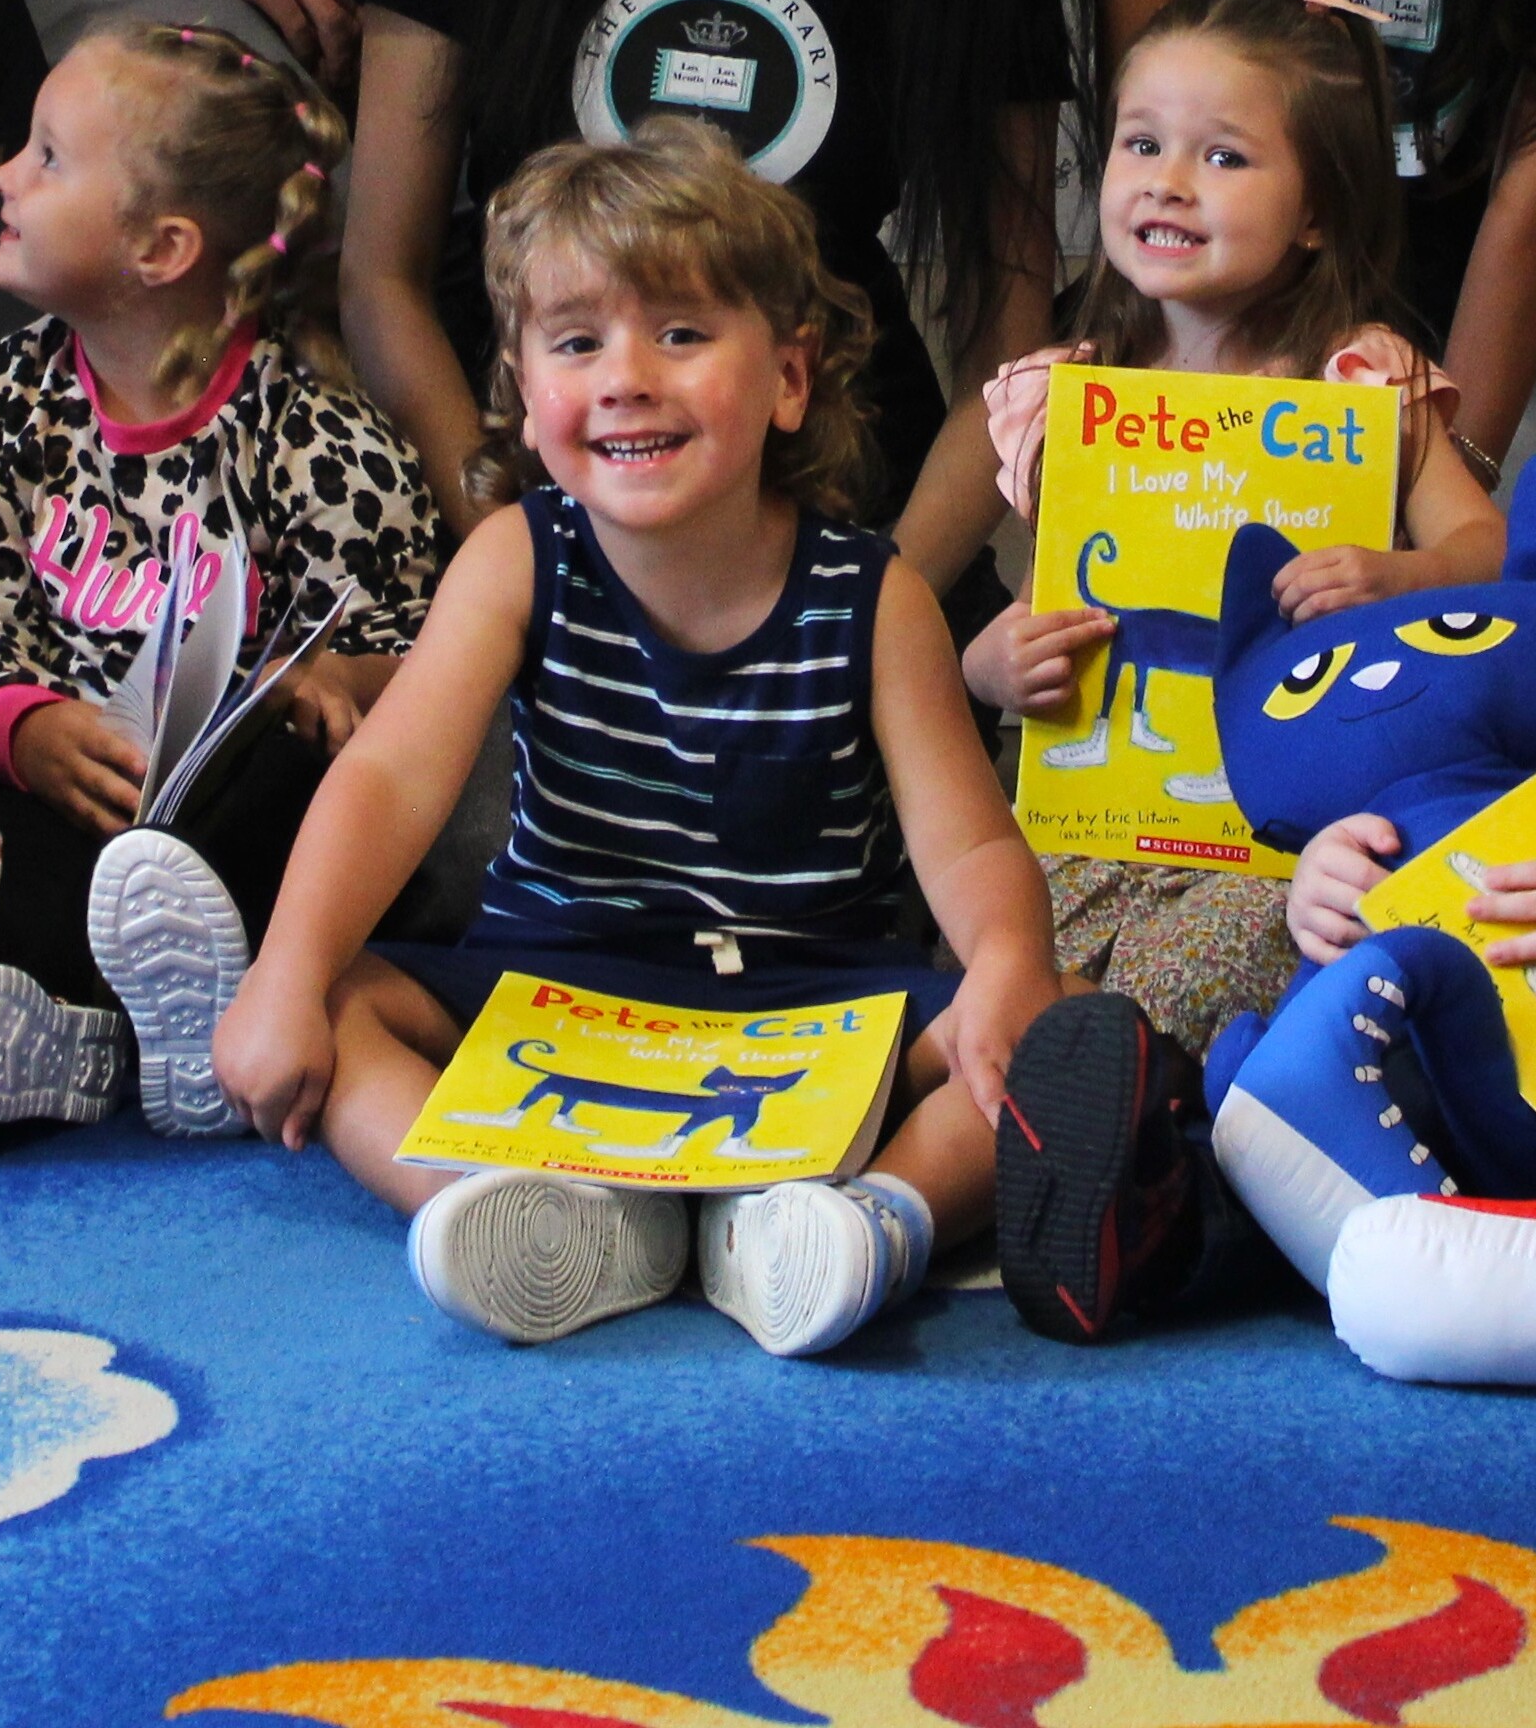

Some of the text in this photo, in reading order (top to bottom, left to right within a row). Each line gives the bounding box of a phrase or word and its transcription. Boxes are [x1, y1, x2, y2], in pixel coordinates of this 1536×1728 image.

[1081, 382, 1365, 465] Pete the Cat
[1108, 461, 1248, 495] I Love My
[1174, 499, 1333, 530] White Shoes
[1027, 807, 1181, 826] Story by Eric Litwin
[1221, 820, 1248, 838] Art
[1152, 839, 1250, 860] SCHOLASTIC
[1462, 921, 1485, 946] Art
[531, 985, 865, 1038] Pete the Cat
[555, 1018, 722, 1051] I Love My
[629, 1045, 822, 1063] White Shoes
[562, 1162, 689, 1182] SCHOLASTIC
